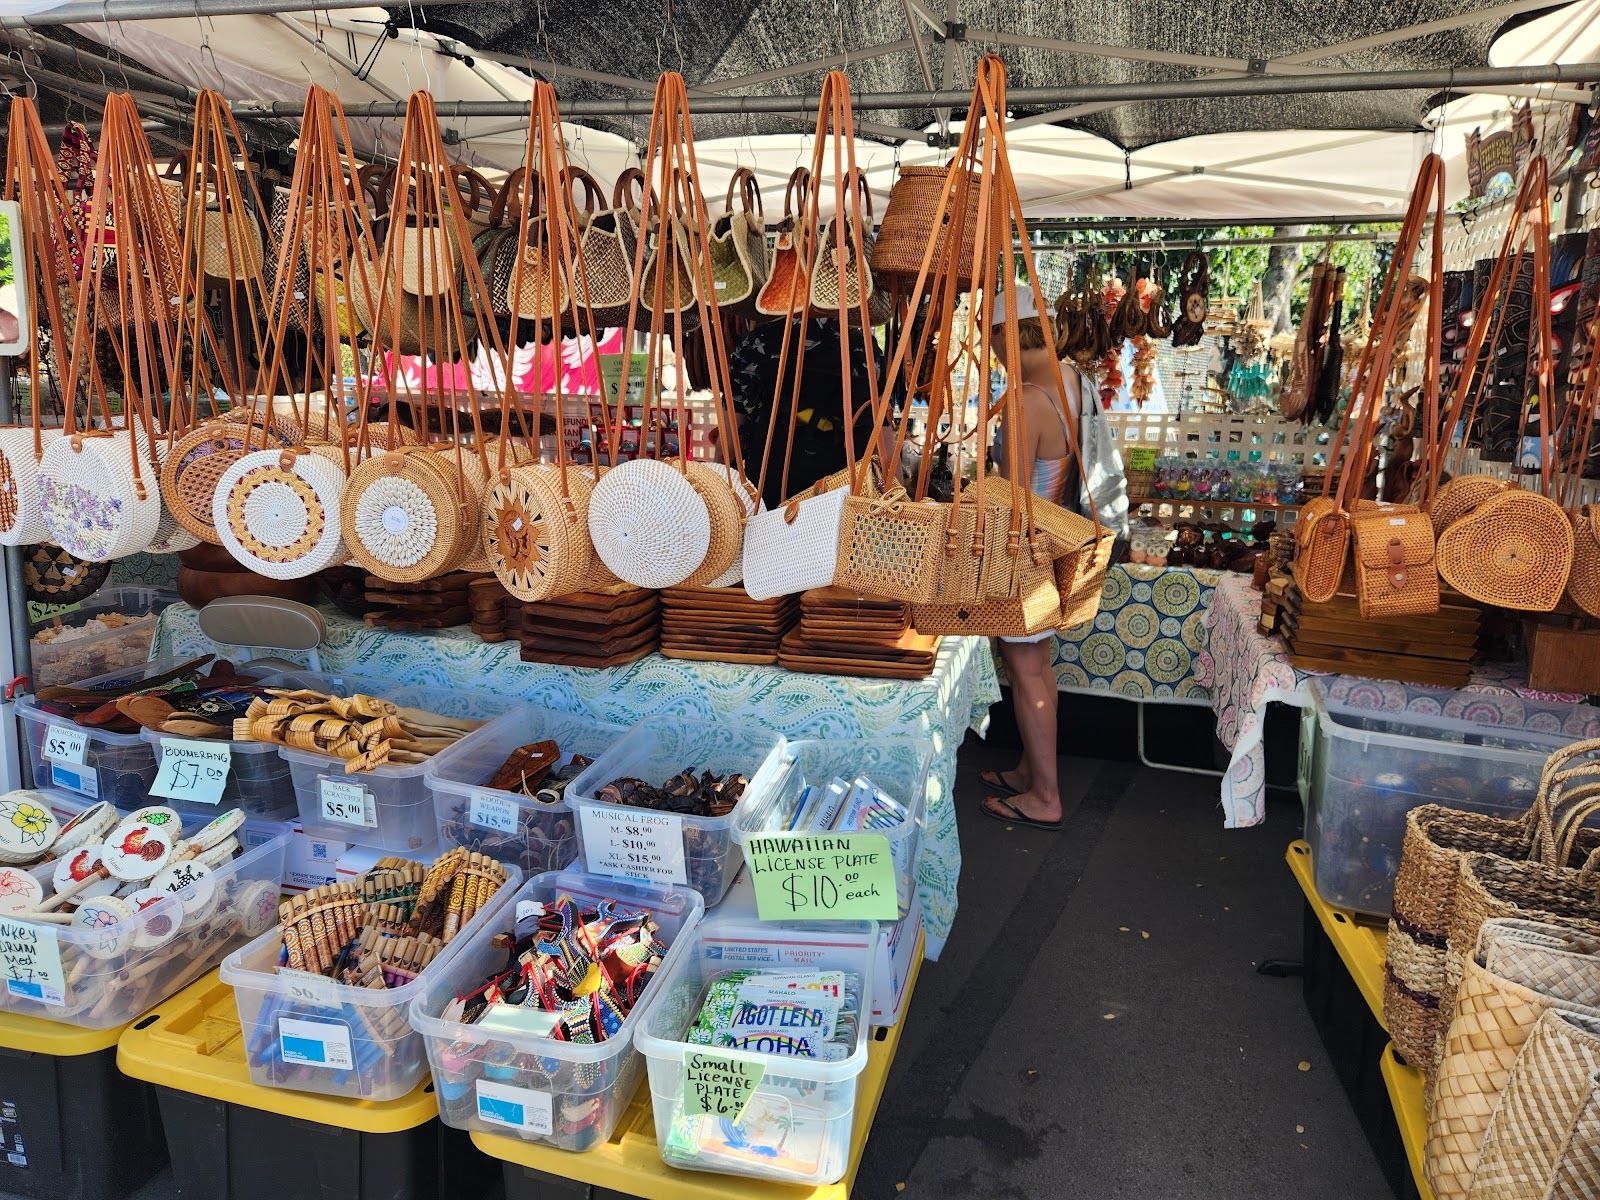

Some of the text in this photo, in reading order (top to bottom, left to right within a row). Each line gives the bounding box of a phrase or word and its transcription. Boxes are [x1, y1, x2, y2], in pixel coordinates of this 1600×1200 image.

[49, 739, 81, 756] $5.00
[165, 746, 228, 763] BOOMERANG
[169, 759, 224, 791] $7.00
[323, 790, 362, 802] SCRATCHER
[332, 784, 351, 793] BACK
[326, 801, 360, 818] $5.00
[480, 802, 511, 815] WEAPON
[477, 811, 512, 827] $15.00
[592, 810, 669, 826] MUSICAL FROG
[610, 825, 652, 837] M- $8.00
[610, 839, 656, 851] L- $10.00
[609, 852, 661, 864] XL- $15.00
[831, 853, 880, 870] PLATE
[620, 864, 656, 873] CASHIER
[624, 871, 649, 879] STICK
[782, 872, 881, 912] $10.00 each
[747, 946, 769, 954] STATES
[5, 964, 49, 983] $7.00
[690, 1053, 746, 1075] Small
[694, 1083, 742, 1099] PLATE
